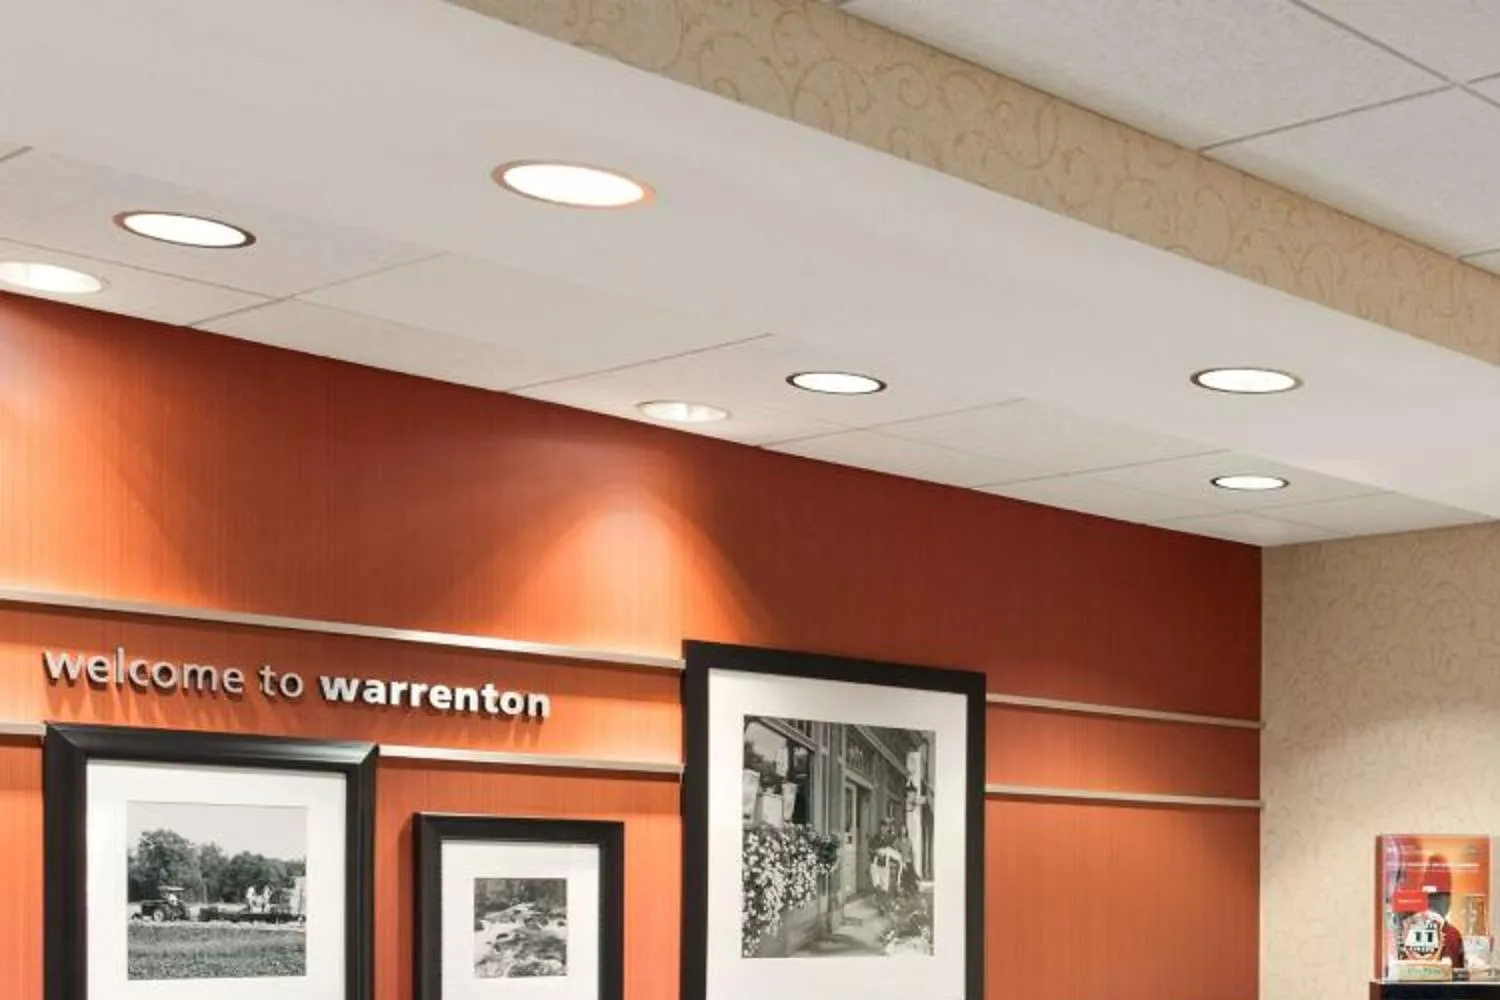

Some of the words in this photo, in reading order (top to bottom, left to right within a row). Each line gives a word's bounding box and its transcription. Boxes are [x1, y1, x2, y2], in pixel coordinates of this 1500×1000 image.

[43, 646, 245, 693] welcome
[259, 664, 304, 697] to
[319, 675, 551, 718] warrenton
